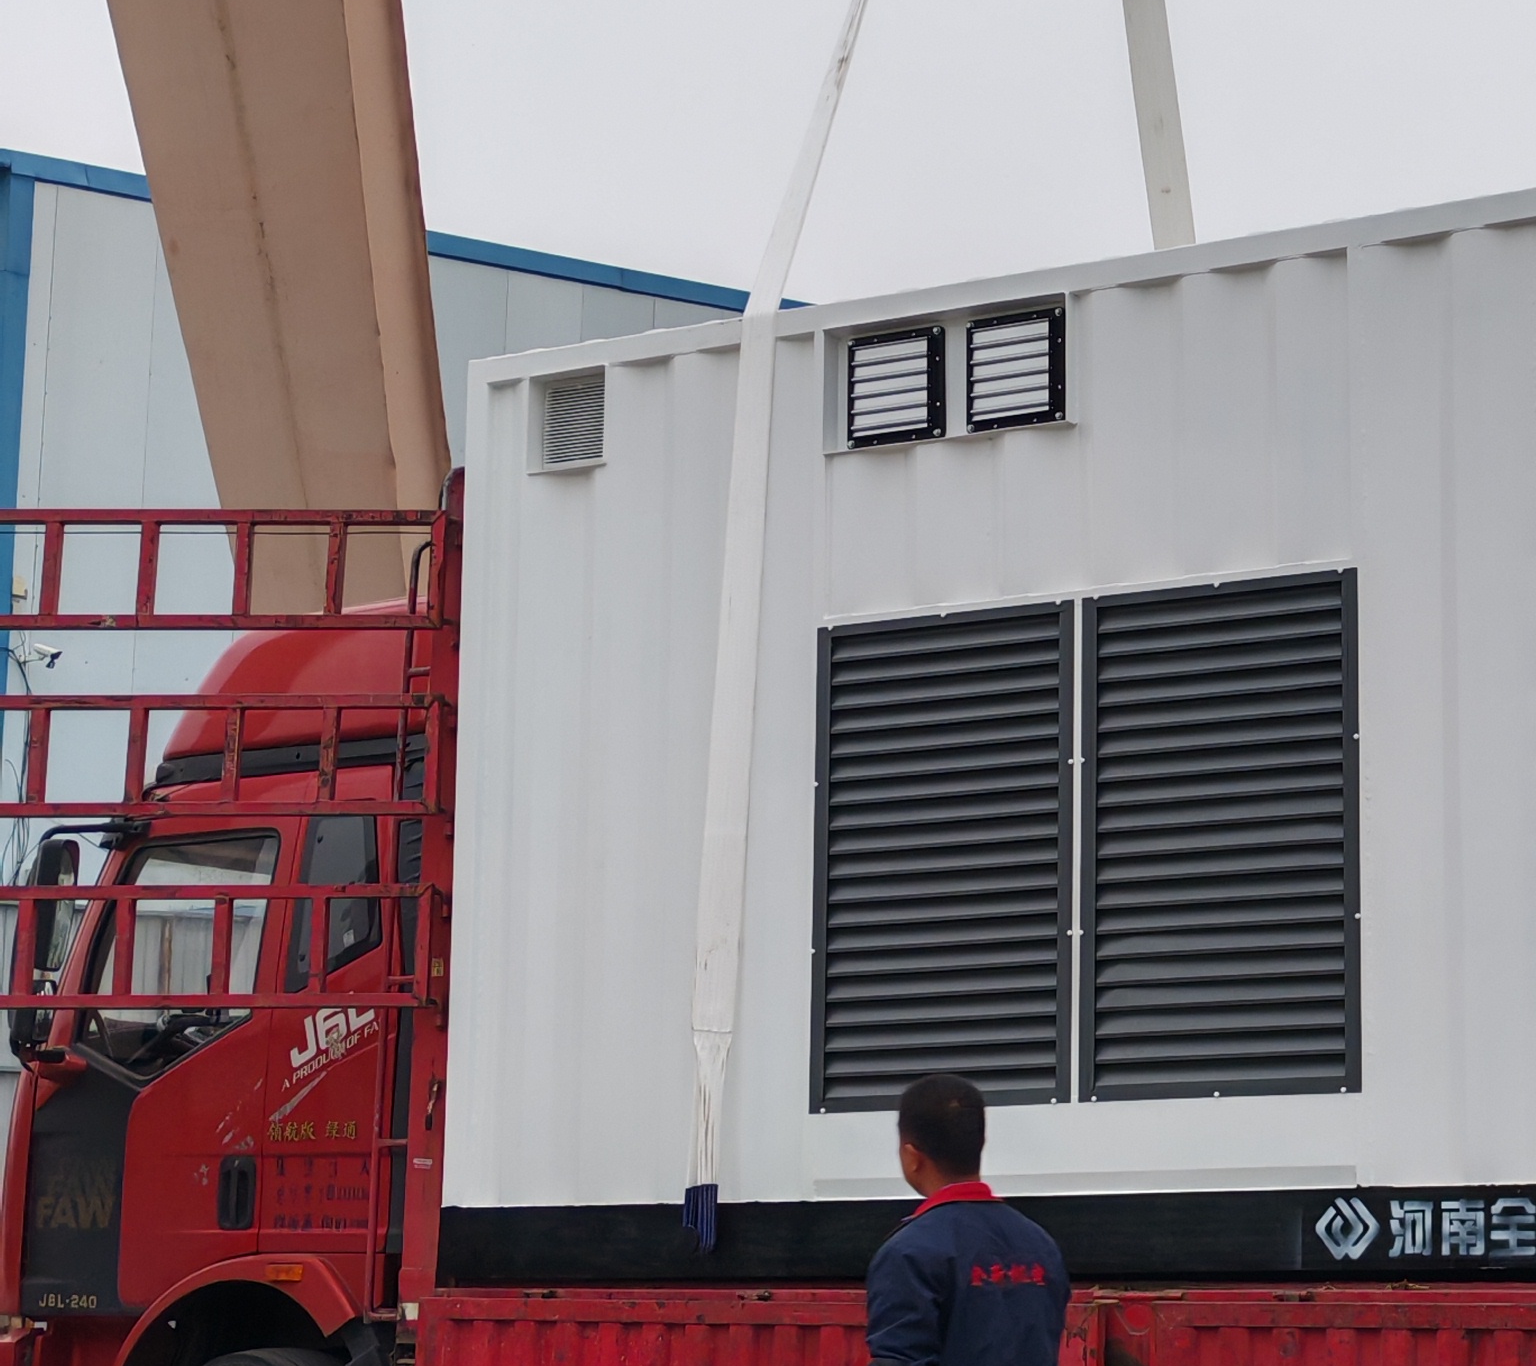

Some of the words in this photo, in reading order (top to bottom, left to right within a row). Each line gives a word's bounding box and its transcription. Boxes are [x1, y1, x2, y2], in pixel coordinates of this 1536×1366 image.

[347, 1031, 361, 1049] OF
[364, 1021, 380, 1038] FA
[35, 1196, 115, 1228] FAW
